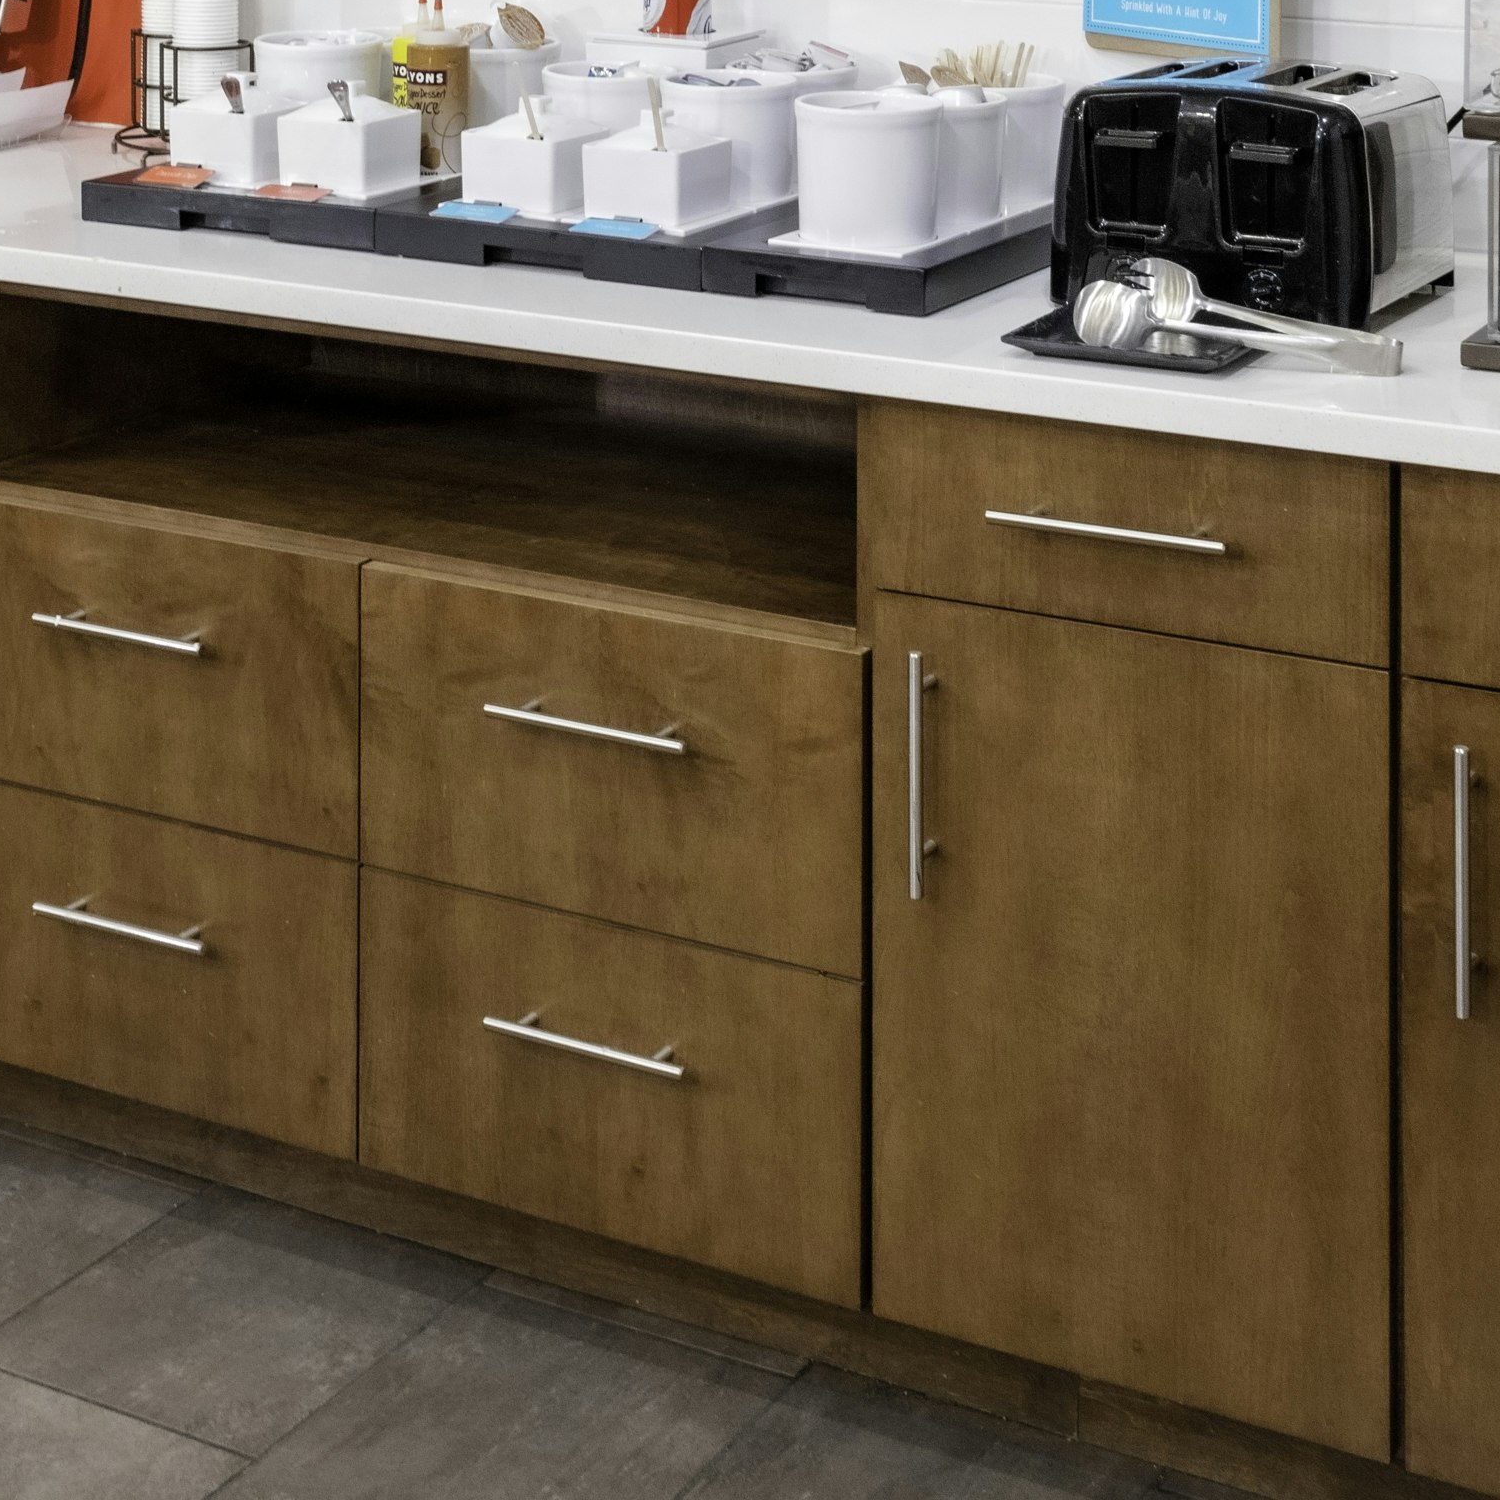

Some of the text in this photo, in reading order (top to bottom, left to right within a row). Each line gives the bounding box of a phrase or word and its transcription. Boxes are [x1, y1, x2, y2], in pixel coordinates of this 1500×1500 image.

[1156, 2, 1173, 16] With
[1175, 4, 1182, 17] A
[1184, 6, 1200, 19] Hint
[1202, 8, 1212, 20] Of
[1213, 9, 1228, 25] Joy
